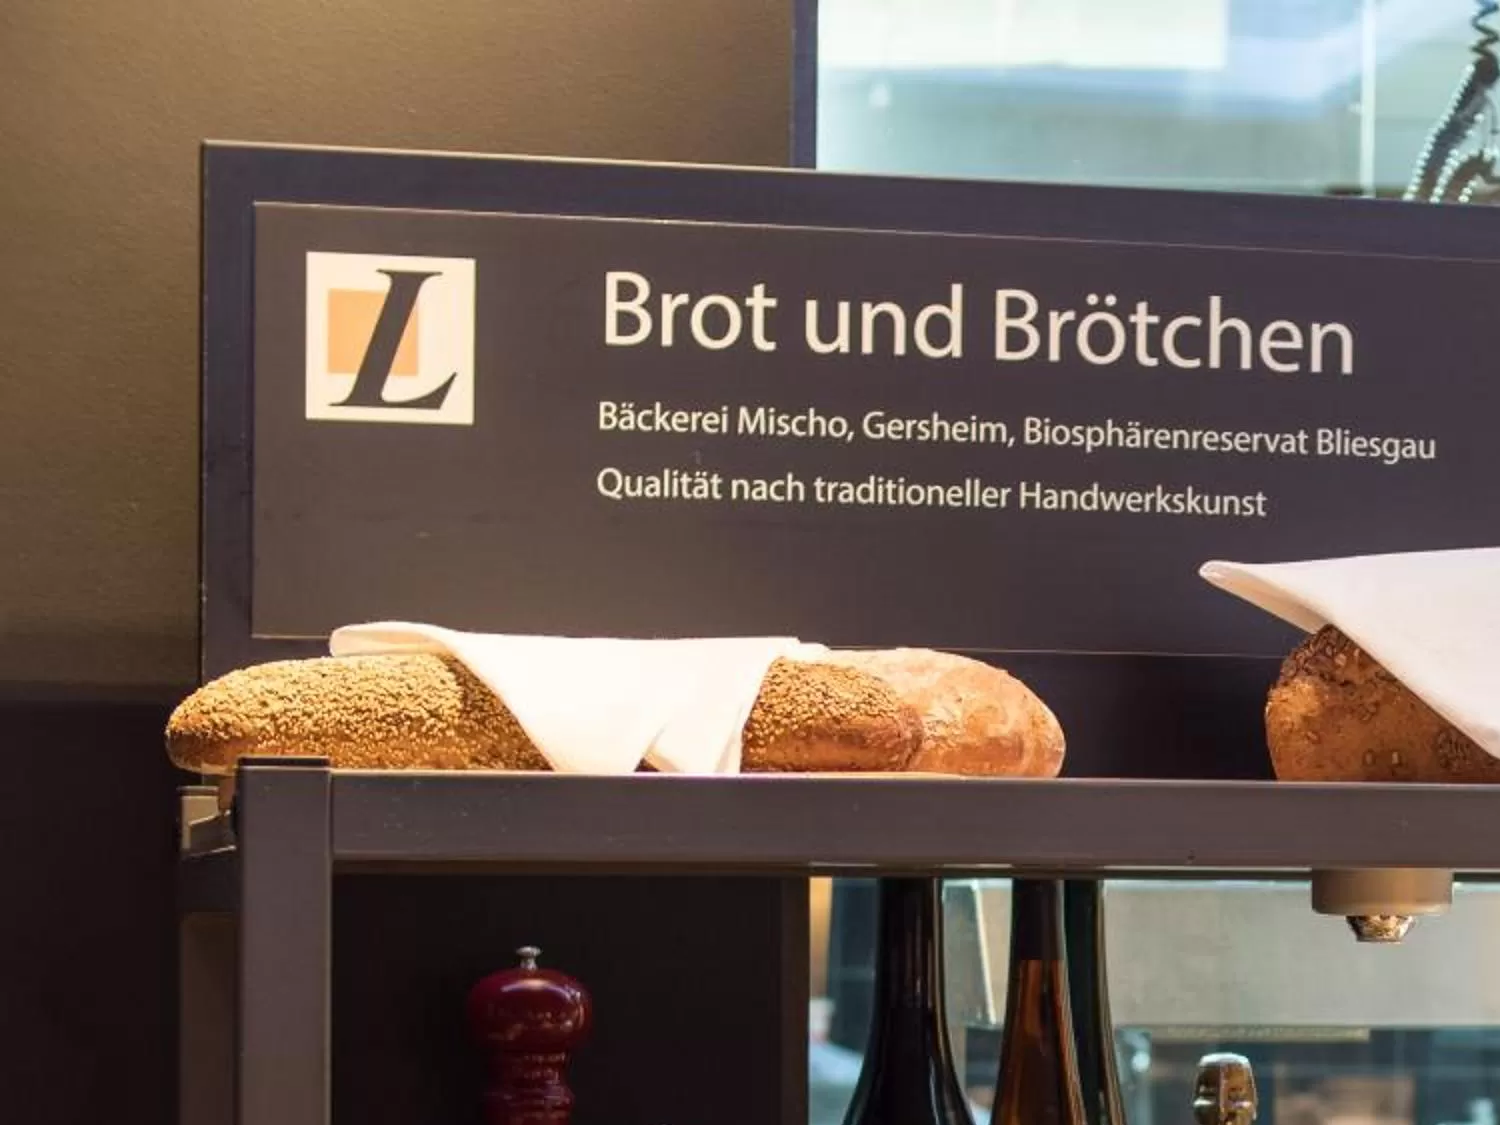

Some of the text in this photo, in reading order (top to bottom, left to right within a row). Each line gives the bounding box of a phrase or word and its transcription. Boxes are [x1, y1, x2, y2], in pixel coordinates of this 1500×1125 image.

[328, 269, 457, 410] L
[602, 270, 1355, 374] Brot und Brötchen
[598, 401, 1436, 465] Bäckerei Mischo, Gersheim, Biosphärenreservat Bliesgau
[597, 467, 1267, 517] Qualität nach traditioneller Handwerkskunst
